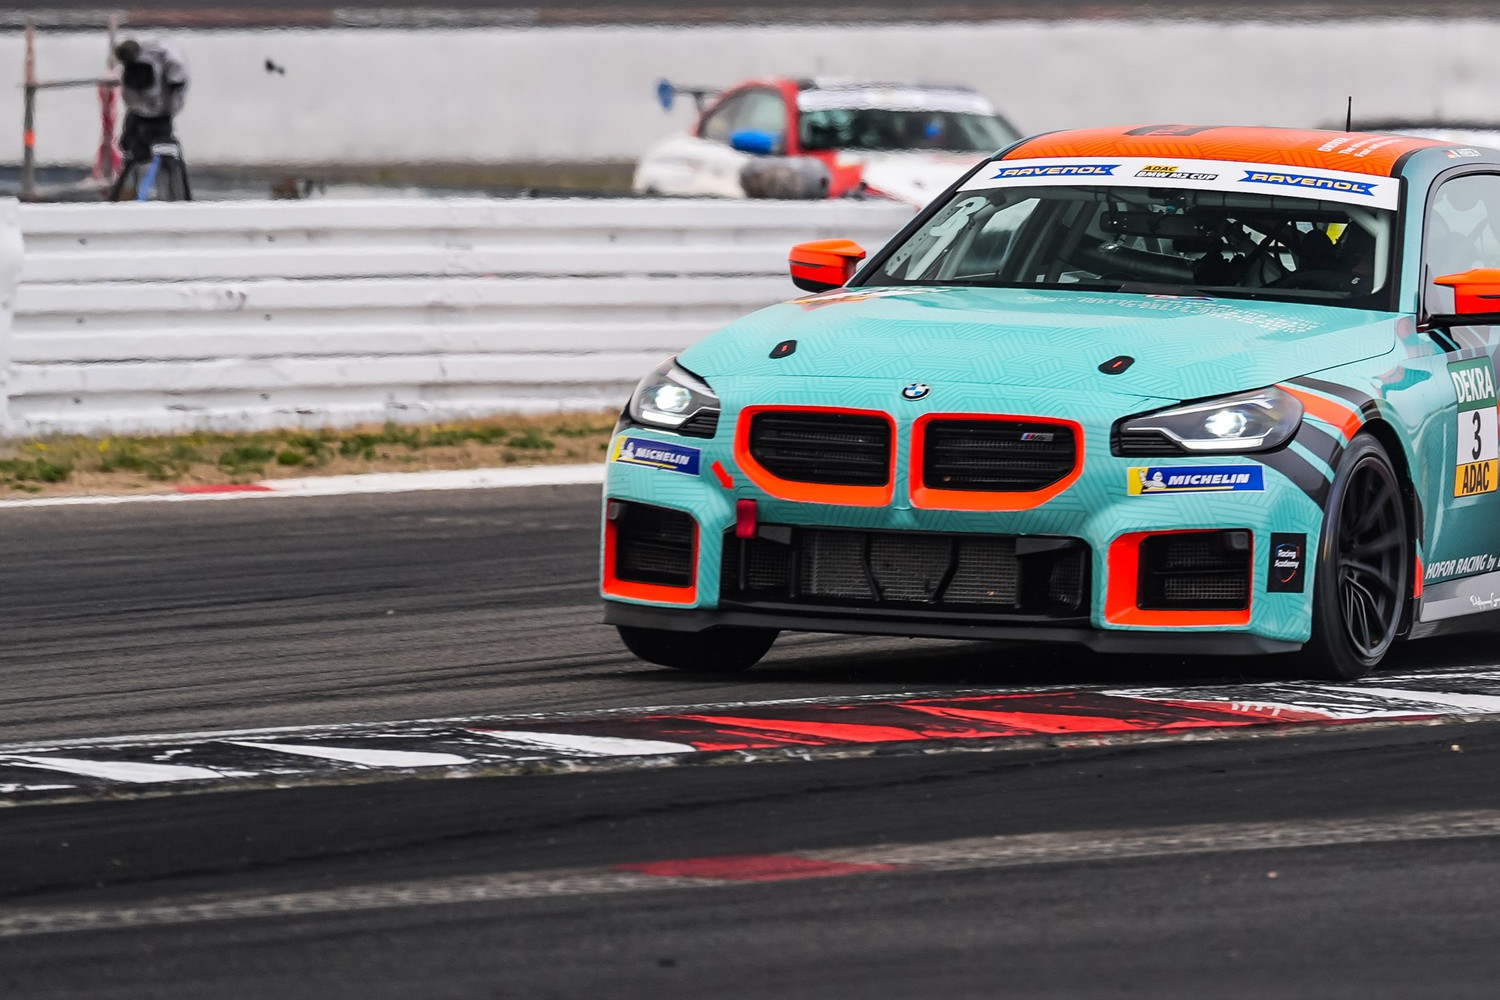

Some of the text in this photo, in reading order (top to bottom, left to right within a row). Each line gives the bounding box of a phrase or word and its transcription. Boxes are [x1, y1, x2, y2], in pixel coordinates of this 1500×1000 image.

[1002, 166, 1109, 177] RAVENOL
[1251, 173, 1369, 193] RAVENOL
[1451, 365, 1496, 404] DEKRA
[1471, 411, 1482, 460] 3
[635, 447, 690, 465] MICHELIN
[1168, 473, 1250, 486] MICHELIN
[1461, 461, 1490, 495] ADAC
[1425, 560, 1455, 579] HOFOR
[1455, 554, 1488, 576] RACING
[1488, 554, 1496, 571] by
